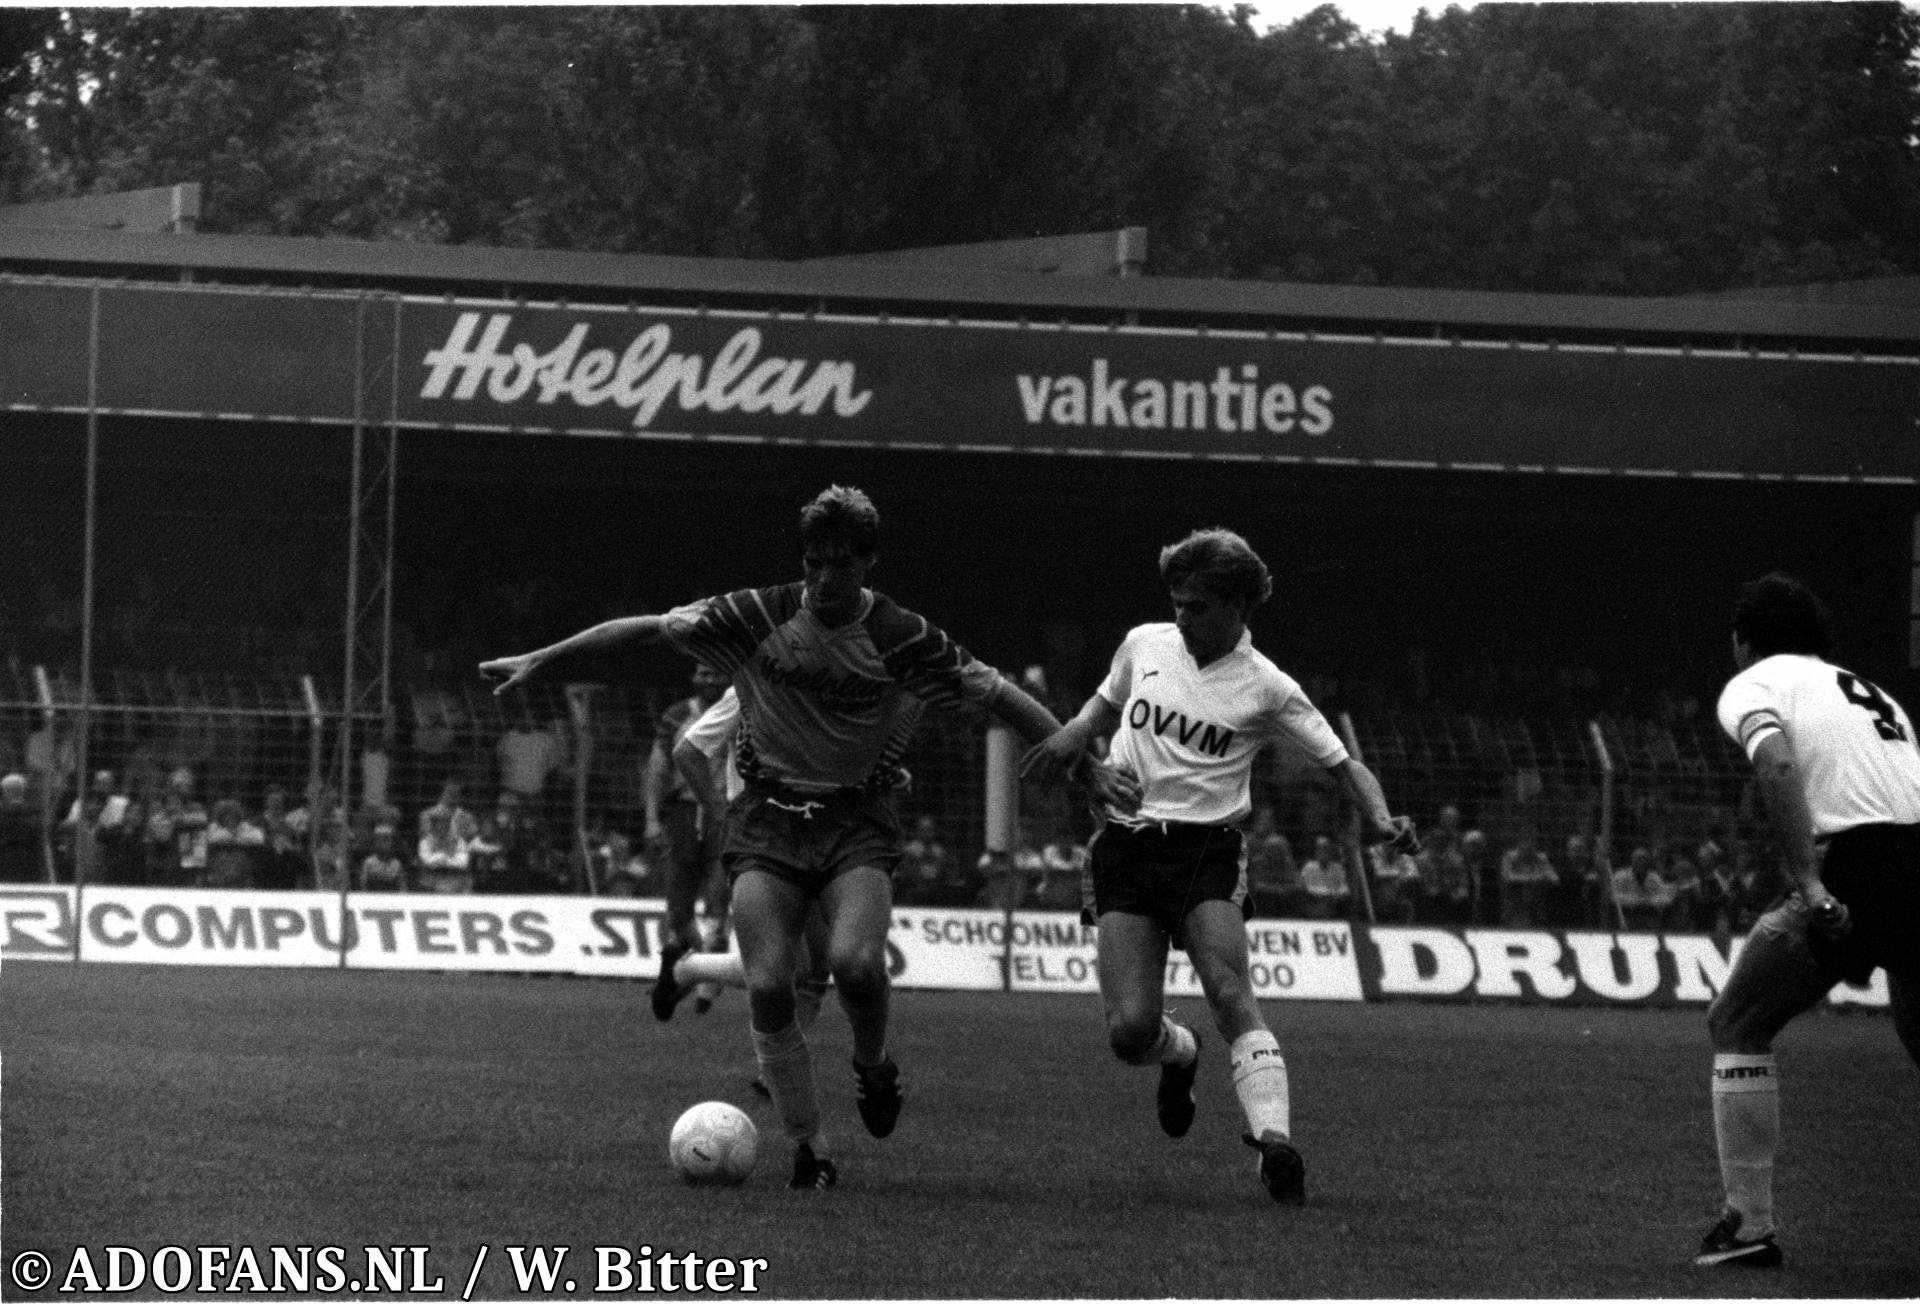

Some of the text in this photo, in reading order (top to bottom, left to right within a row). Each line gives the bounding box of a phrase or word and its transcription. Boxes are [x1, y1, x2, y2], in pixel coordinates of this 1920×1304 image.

[420, 312, 1335, 435] Hotelplan vakanties
[1129, 698, 1235, 759] OVVM
[87, 902, 555, 956] COMPUTERS
[1313, 931, 1347, 956] BV
